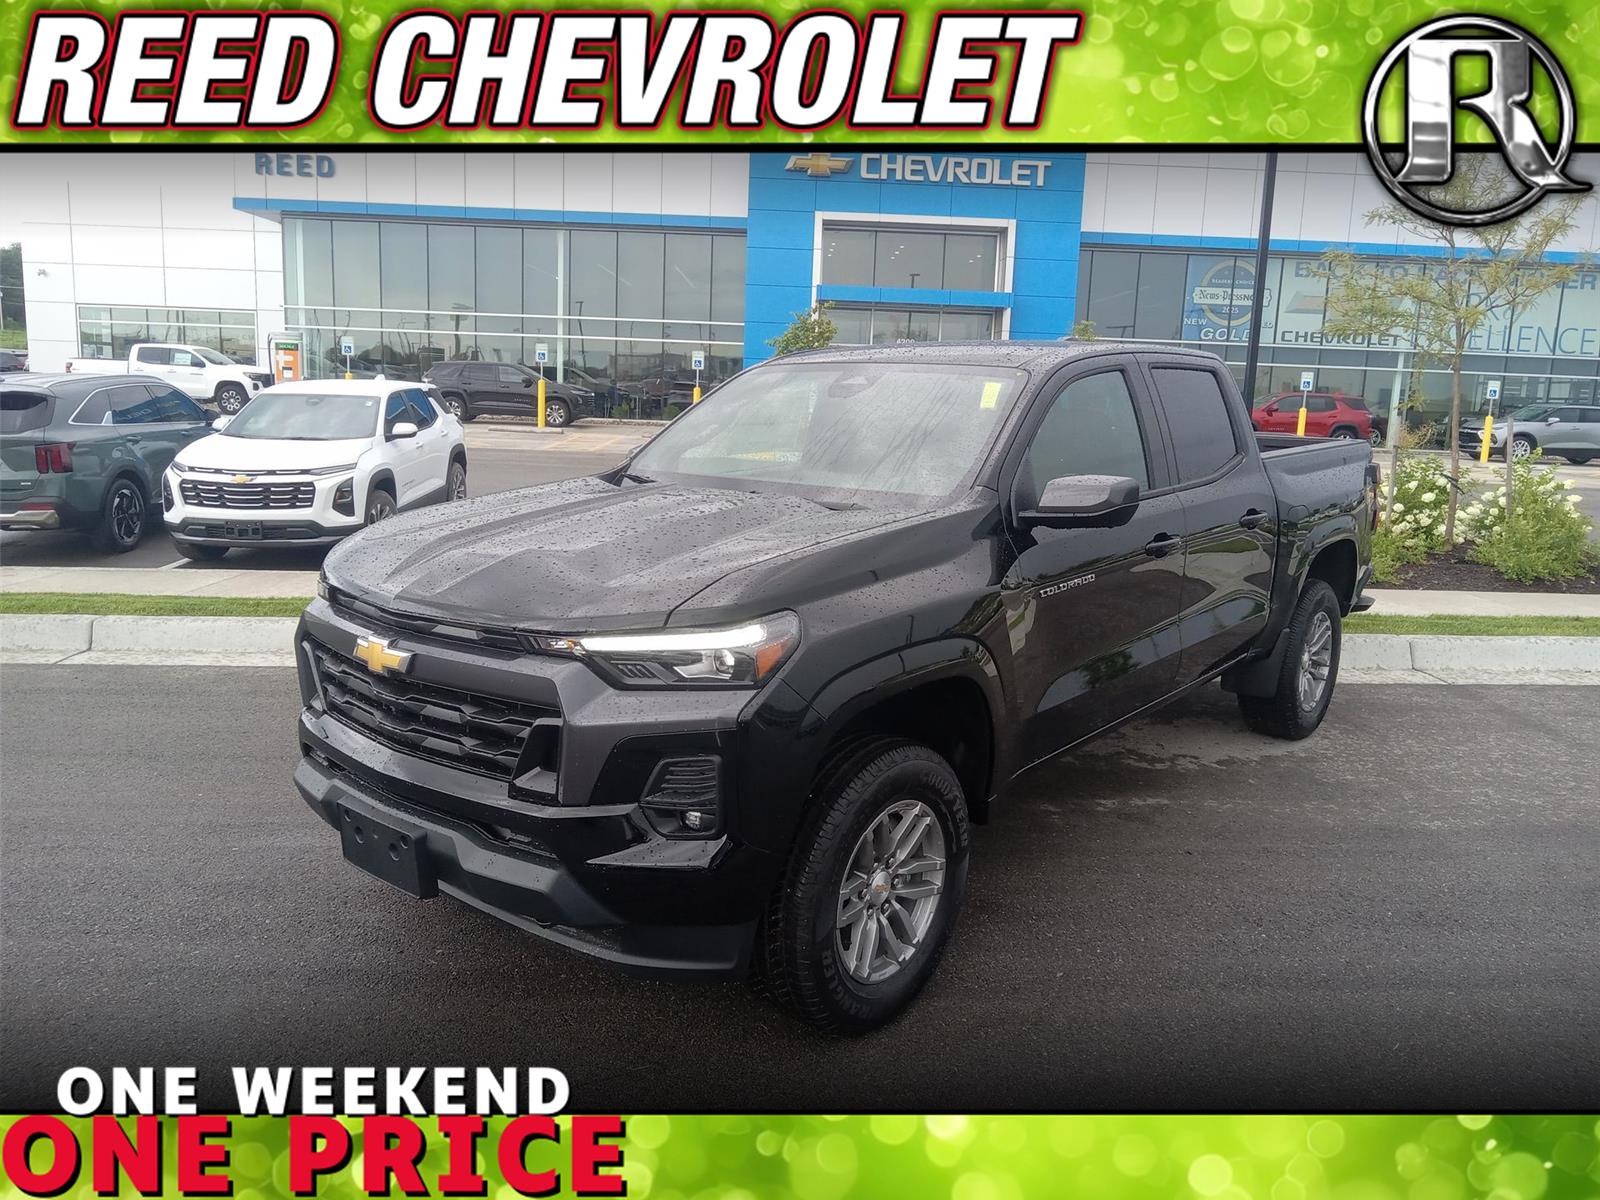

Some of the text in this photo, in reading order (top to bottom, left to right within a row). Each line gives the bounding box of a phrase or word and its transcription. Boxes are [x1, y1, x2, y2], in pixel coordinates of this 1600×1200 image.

[255, 152, 336, 178] REED
[860, 153, 1052, 187] CHEVROLET
[1183, 317, 1208, 326] NEW
[1280, 330, 1399, 347] CHEVROLET
[1039, 574, 1096, 598] COLORADO
